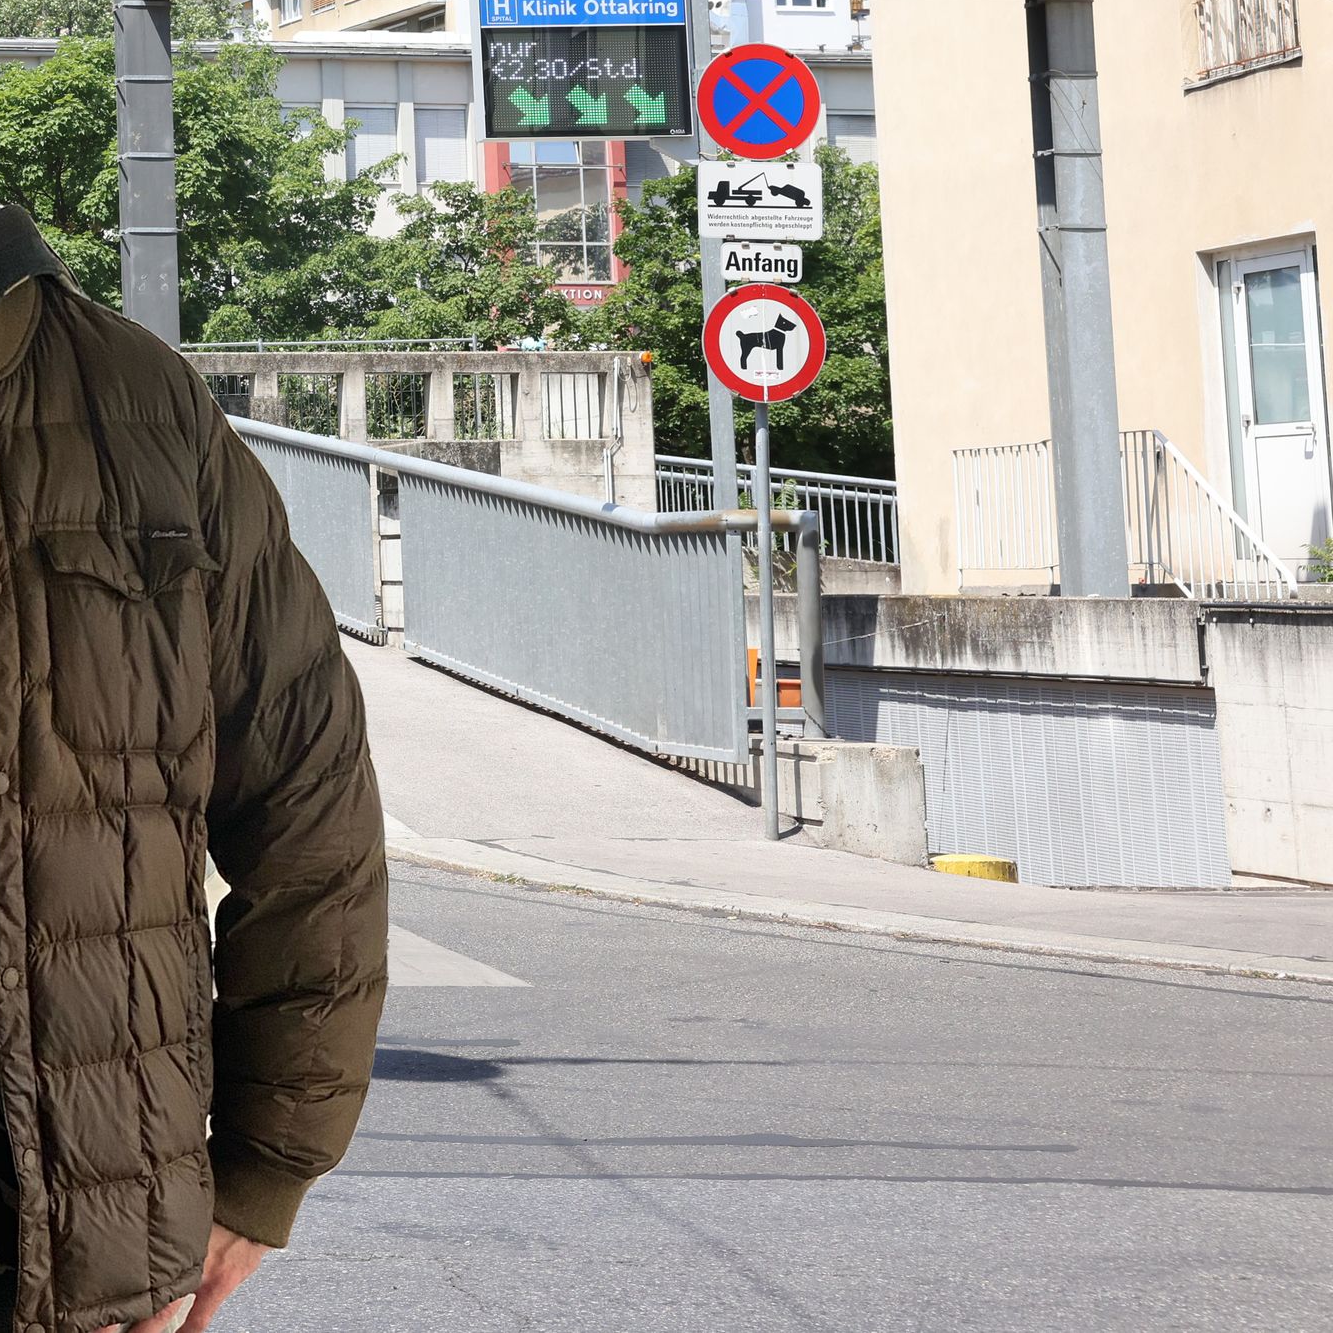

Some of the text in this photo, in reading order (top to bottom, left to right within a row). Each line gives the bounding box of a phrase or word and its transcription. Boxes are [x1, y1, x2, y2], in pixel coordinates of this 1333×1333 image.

[522, 0, 577, 16] Klinik
[490, 42, 537, 58] nur
[784, 214, 813, 222] Fahrzeuge
[724, 251, 798, 278] Anfang
